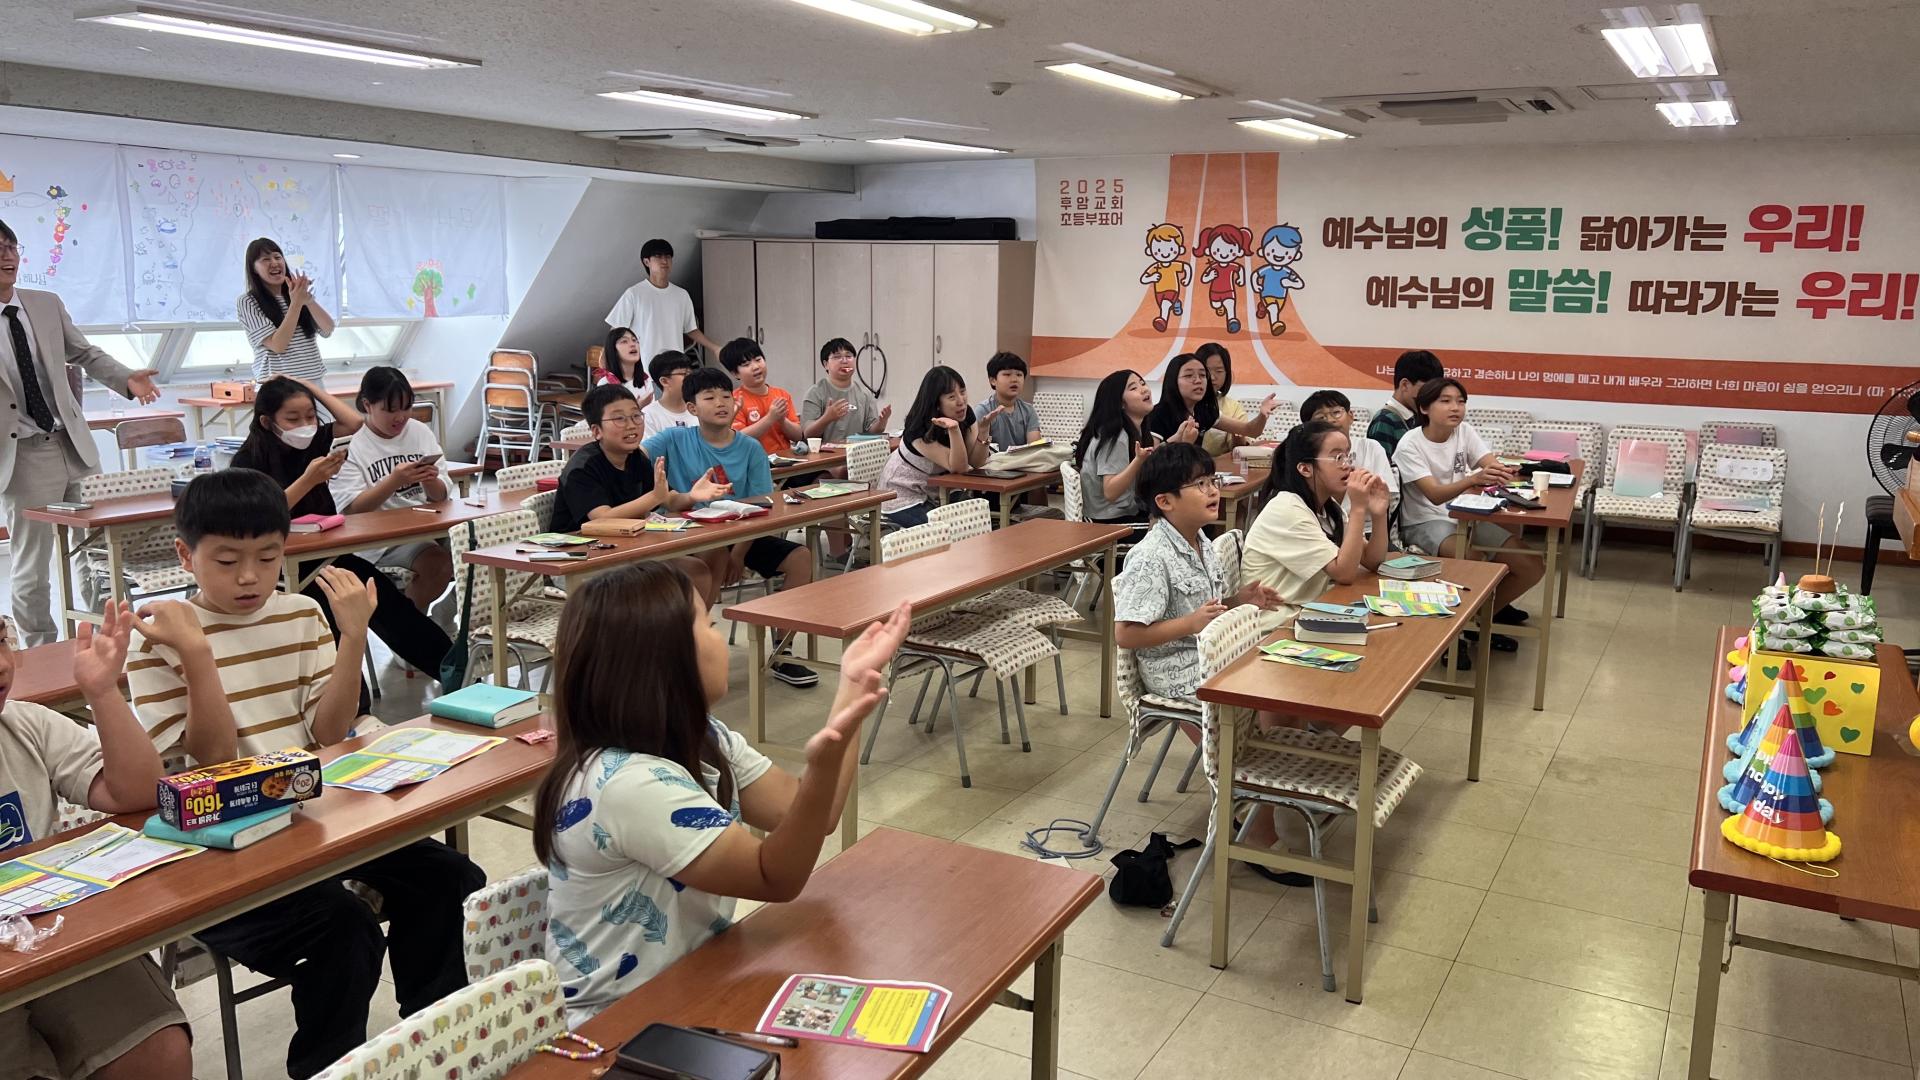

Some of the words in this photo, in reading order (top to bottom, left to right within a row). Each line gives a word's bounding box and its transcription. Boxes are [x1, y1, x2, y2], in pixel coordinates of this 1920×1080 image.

[1060, 179, 1124, 194] 2025
[1060, 212, 1124, 226] 초등부표어
[1322, 216, 1448, 250] 예수님의
[1461, 207, 1563, 251] 성품!
[1580, 215, 1727, 252] 닮아가는
[1743, 204, 1865, 253] 우리!
[1365, 275, 1494, 310] 예수님의
[1508, 268, 1612, 314] 말씀!
[1628, 280, 1779, 317] 따라가는
[1796, 271, 1919, 320] 우리!
[1443, 367, 1472, 379] 유하고
[1474, 368, 1516, 381] 겸손하니
[1518, 370, 1540, 382] 나의
[1577, 373, 1600, 385] 메고
[1603, 375, 1626, 386] 내게
[1628, 375, 1663, 388] 배우라
[1665, 377, 1713, 390] 그리하면
[1715, 379, 1740, 391] 너희
[1742, 380, 1780, 393] 마음이
[1811, 383, 1862, 396] 얻으리니
[185, 792, 224, 816] 160g
